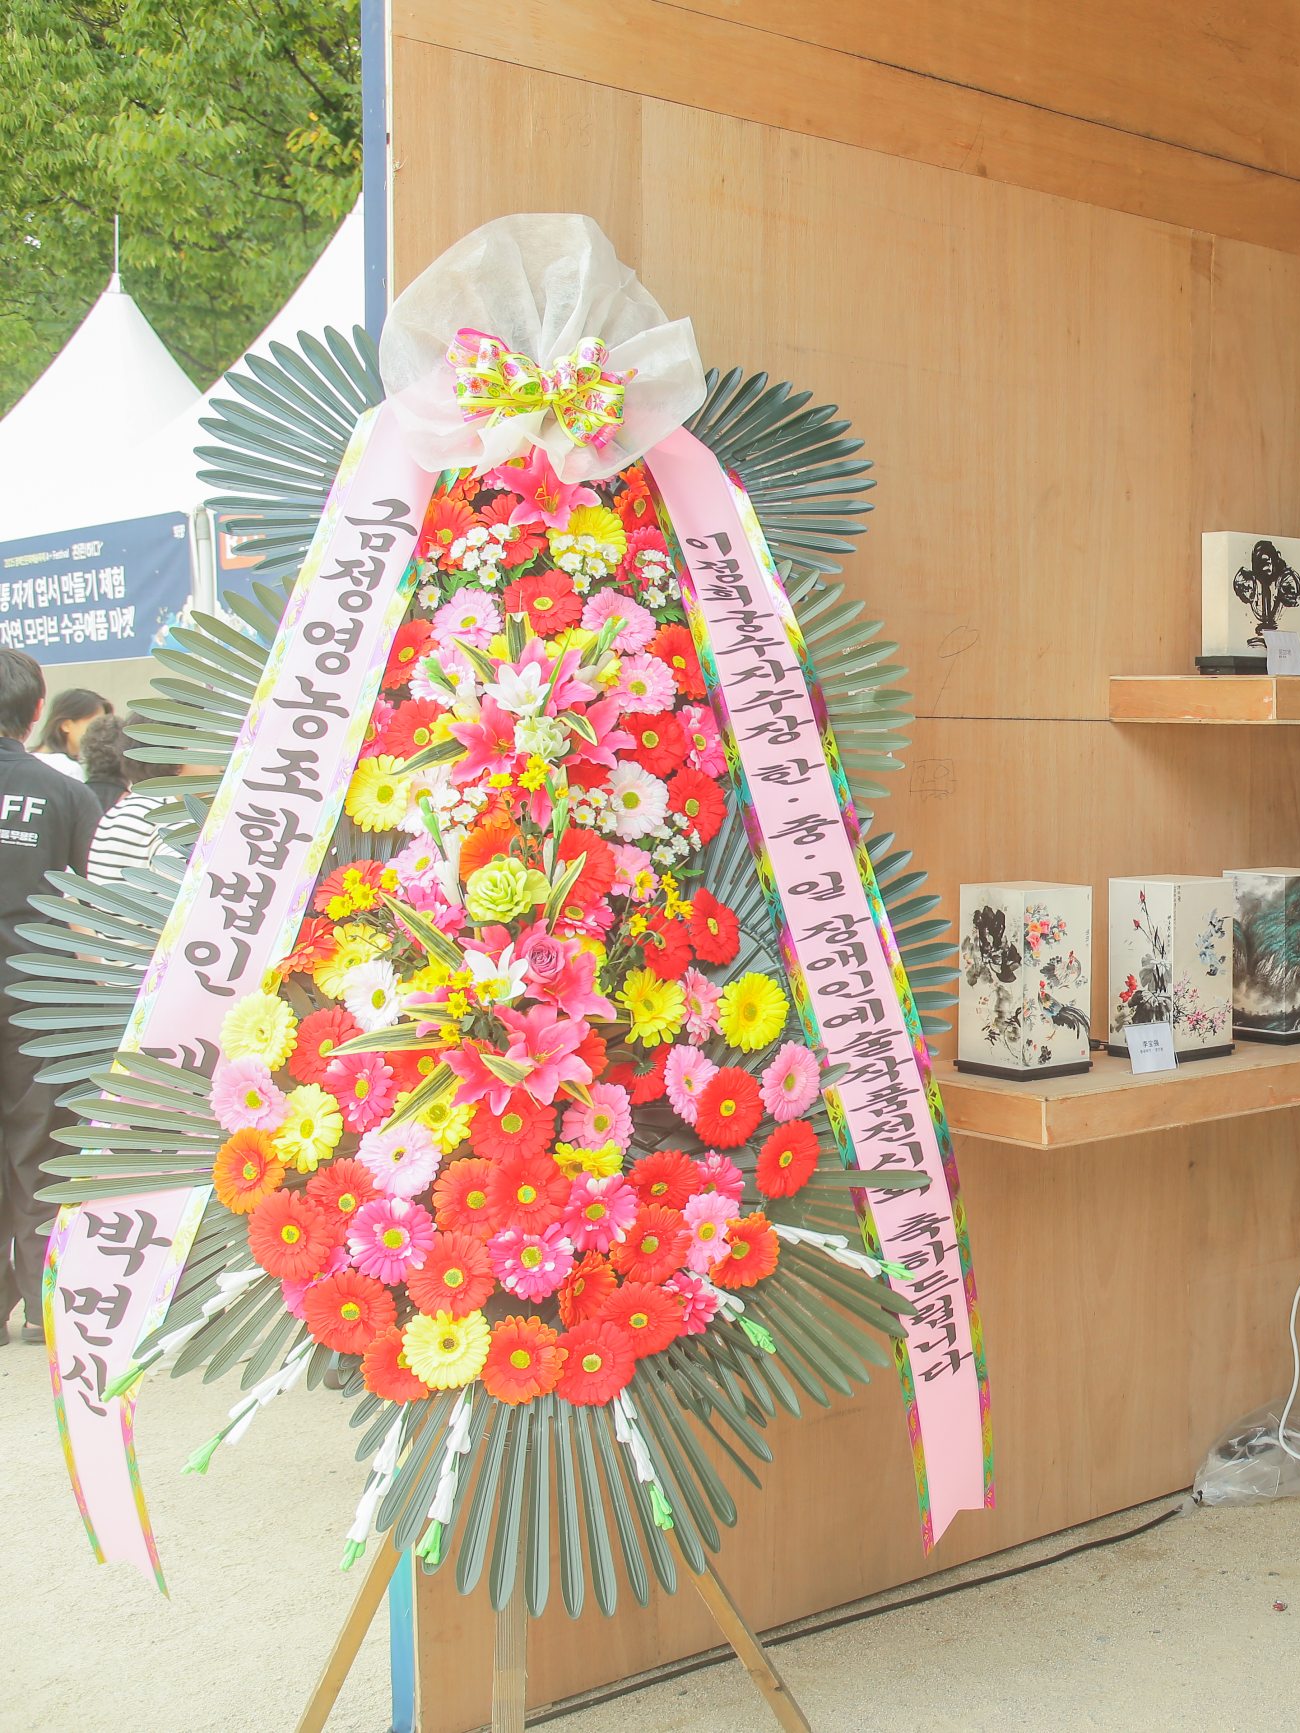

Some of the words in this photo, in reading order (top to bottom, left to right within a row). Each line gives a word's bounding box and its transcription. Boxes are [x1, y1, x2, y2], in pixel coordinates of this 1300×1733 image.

[11, 576, 34, 611] 자개
[35, 572, 60, 606] 엽서
[60, 569, 98, 604] 만들기
[99, 566, 125, 600] 체험
[0, 620, 25, 649] 자연
[25, 616, 60, 647] 모티브
[60, 609, 108, 644] 수공예품
[109, 606, 136, 638] 마켓
[185, 499, 417, 997] 금정영농조합법인
[0, 795, 47, 822] FF
[885, 1212, 974, 1383] 축하드립니다
